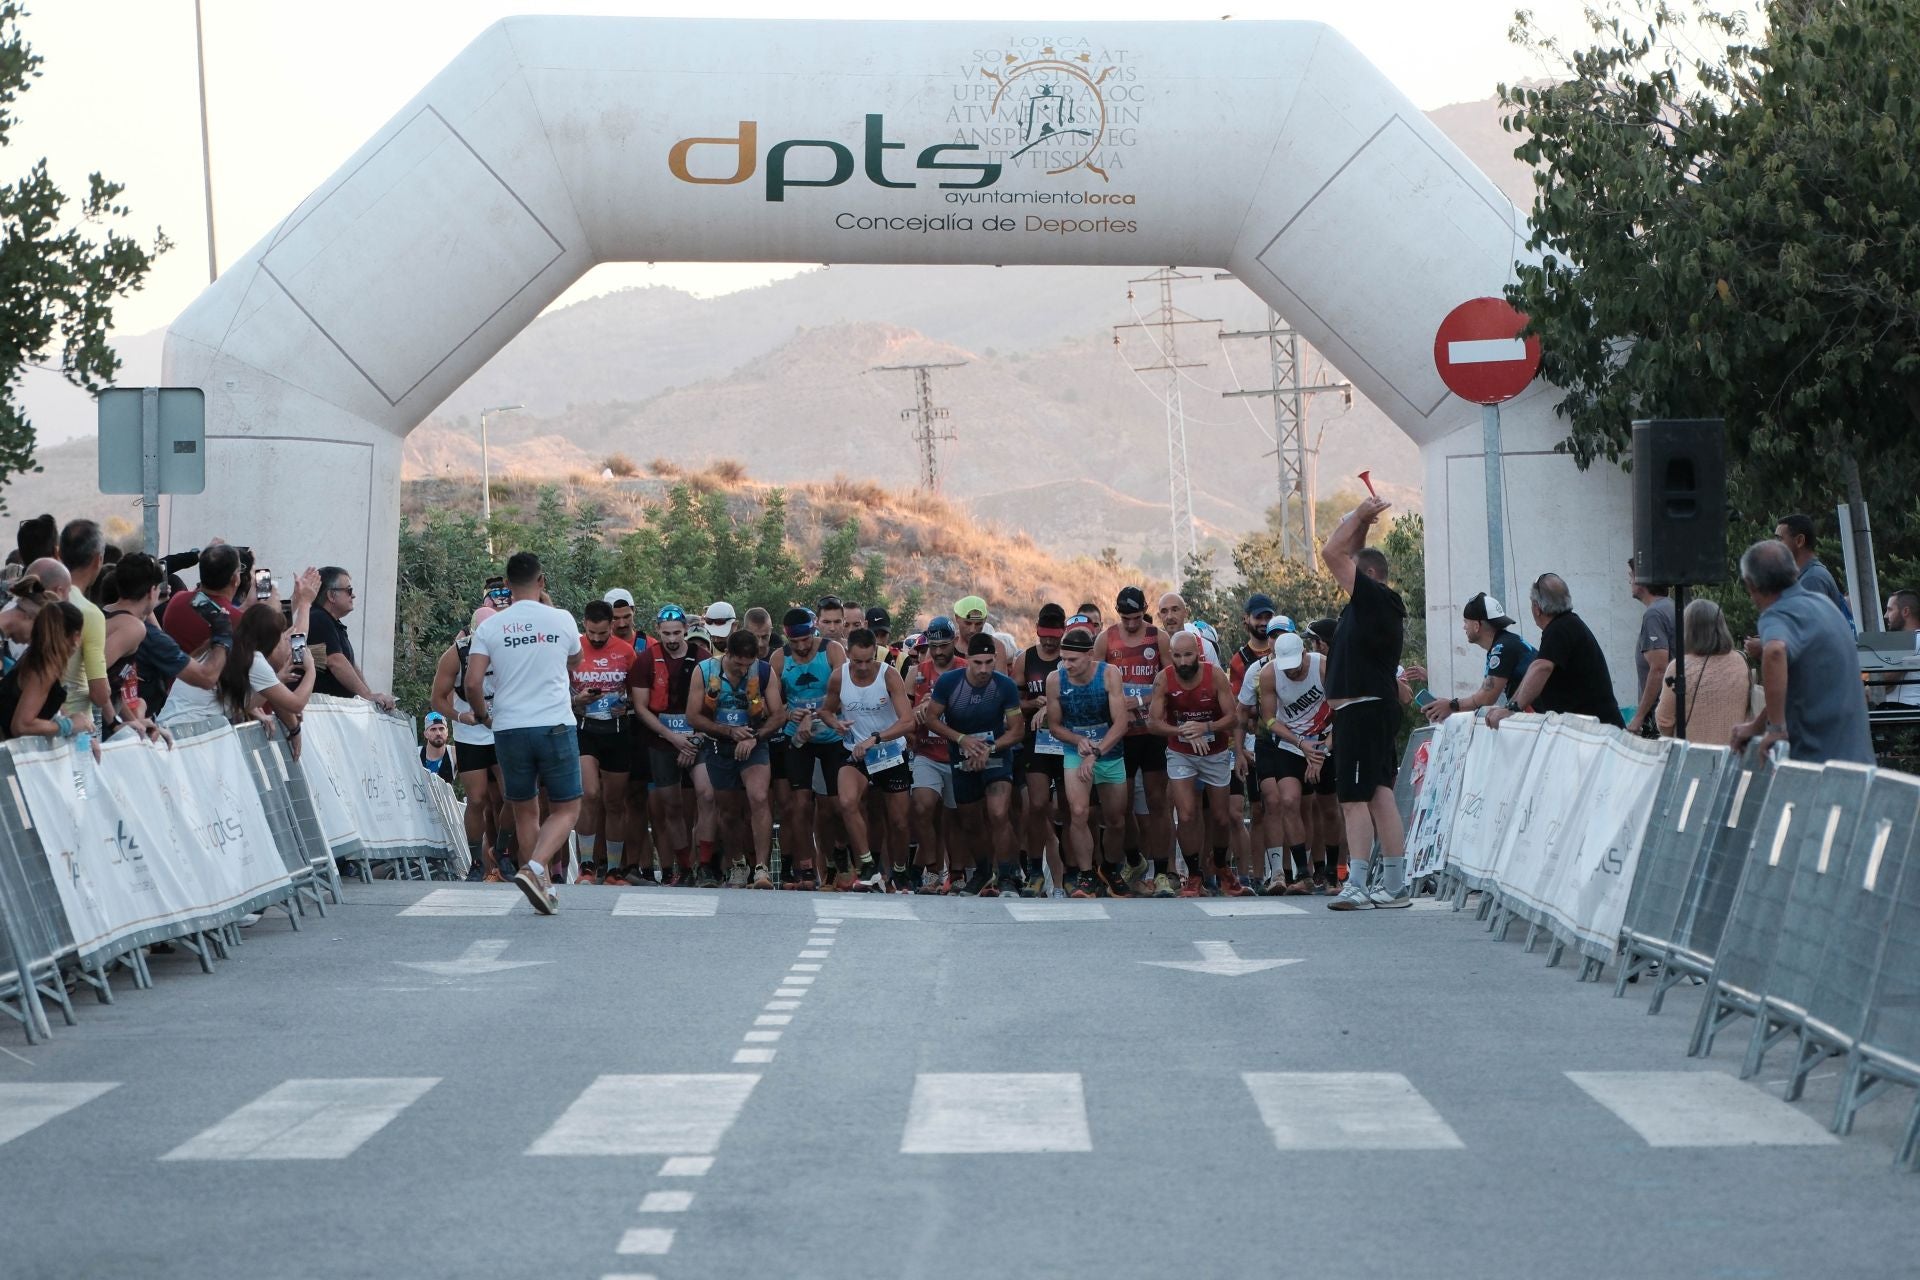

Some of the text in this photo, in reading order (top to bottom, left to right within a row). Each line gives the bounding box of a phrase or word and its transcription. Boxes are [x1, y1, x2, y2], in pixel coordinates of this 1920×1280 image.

[1010, 36, 1090, 48] LORCA
[946, 105, 1142, 124] ATVMENSSMIN
[668, 114, 1002, 202] dpts
[835, 212, 1138, 236] Concejalía de Deportes
[503, 622, 533, 634] Kike
[504, 632, 560, 648] Speaker
[1129, 688, 1141, 697] 95
[598, 699, 609, 708] 25
[668, 719, 684, 728] 102
[726, 713, 739, 722] 64
[1086, 730, 1097, 738] 35
